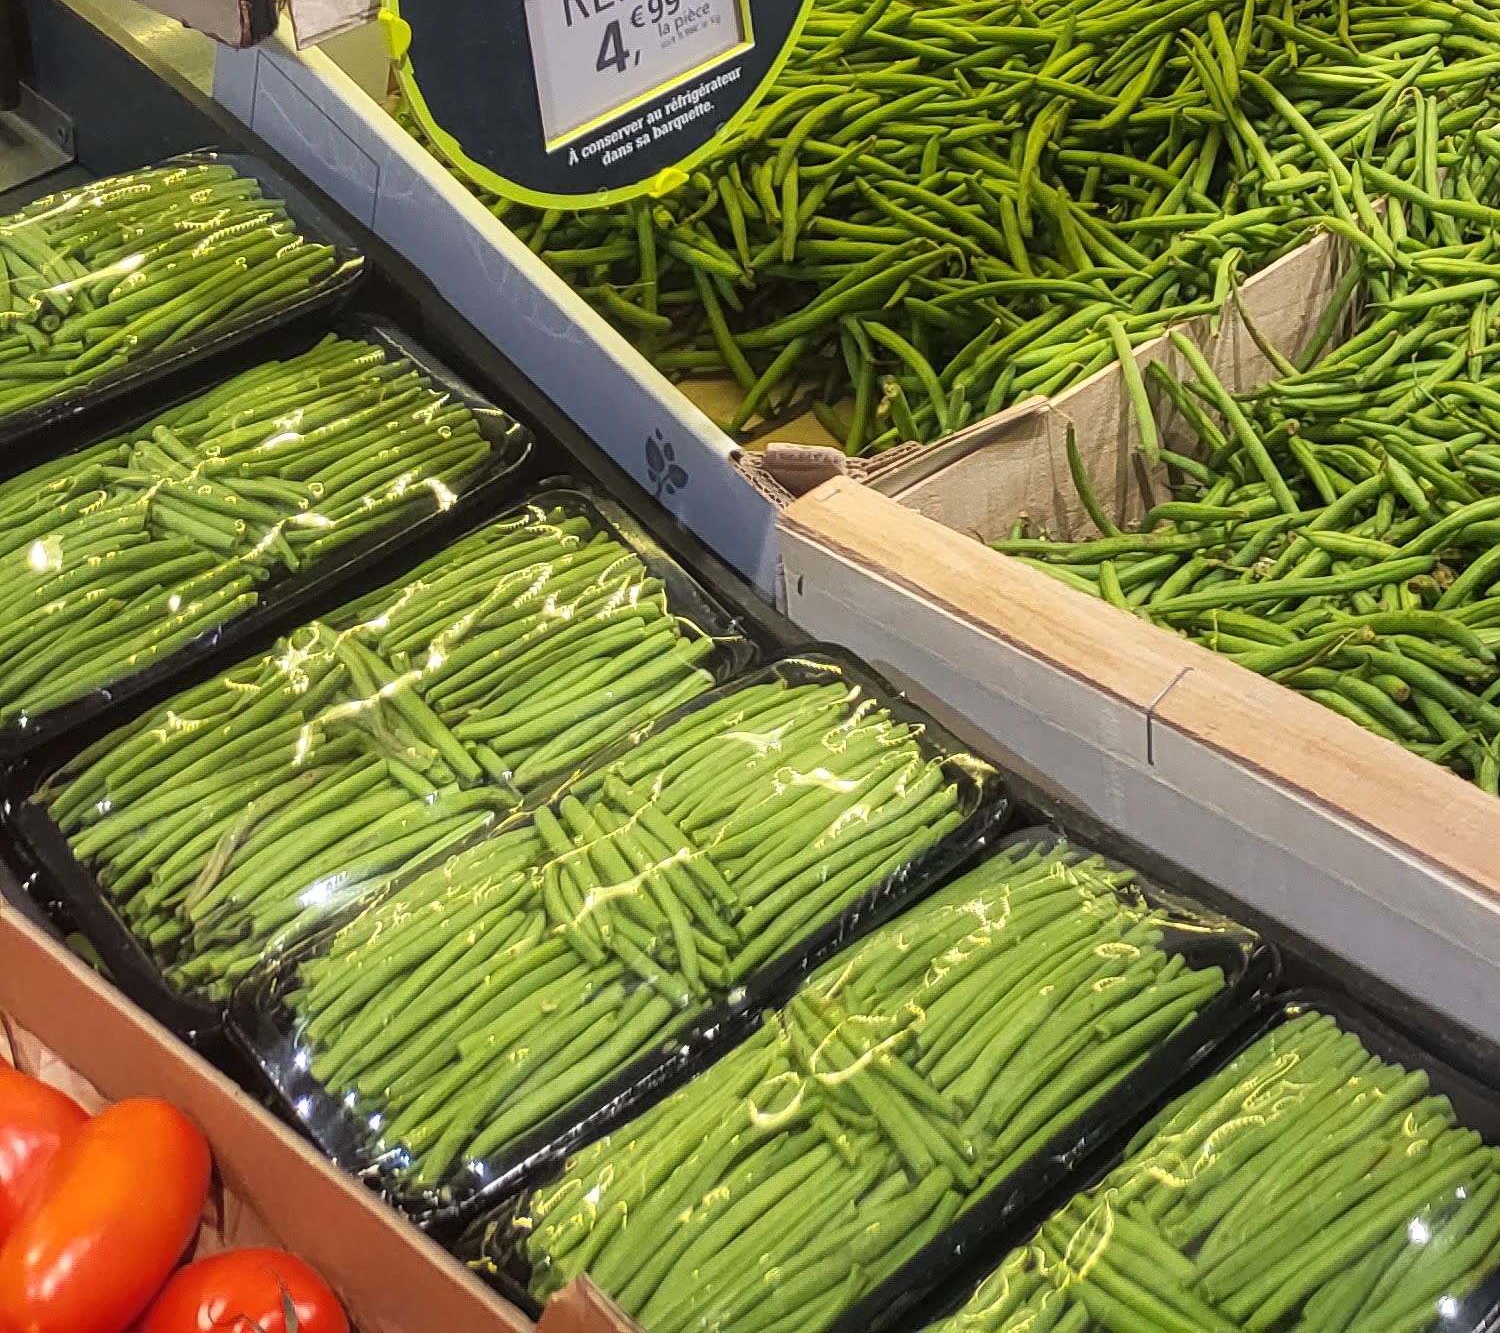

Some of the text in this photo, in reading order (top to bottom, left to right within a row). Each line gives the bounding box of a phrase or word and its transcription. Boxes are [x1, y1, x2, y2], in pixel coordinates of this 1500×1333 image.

[657, 21, 671, 37] la
[674, 1, 711, 31] pièce
[568, 65, 742, 167] À conserver au réfrigérateur
[602, 100, 715, 167] dans sa barquette.
